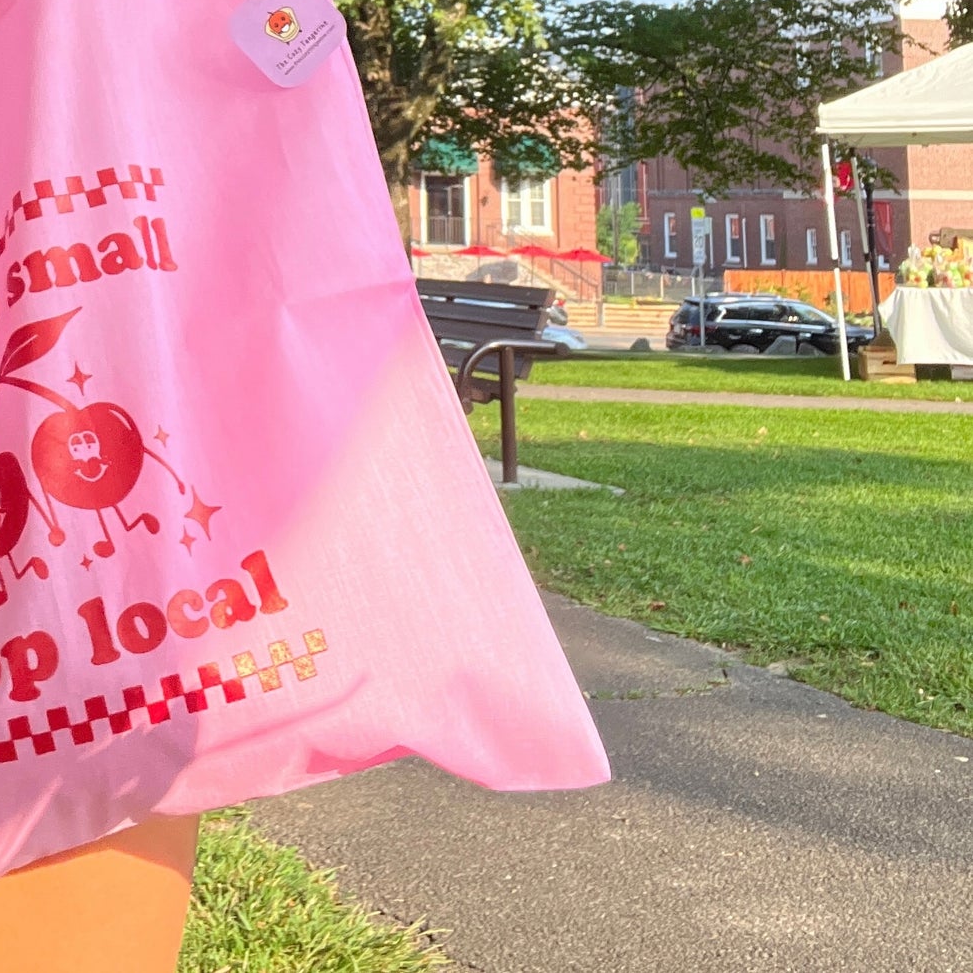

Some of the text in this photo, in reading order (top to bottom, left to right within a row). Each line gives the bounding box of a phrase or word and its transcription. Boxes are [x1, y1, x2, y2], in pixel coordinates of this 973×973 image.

[276, 60, 288, 70] The
[300, 20, 328, 46] Tangerine
[7, 215, 178, 308] small
[77, 549, 289, 665] local
